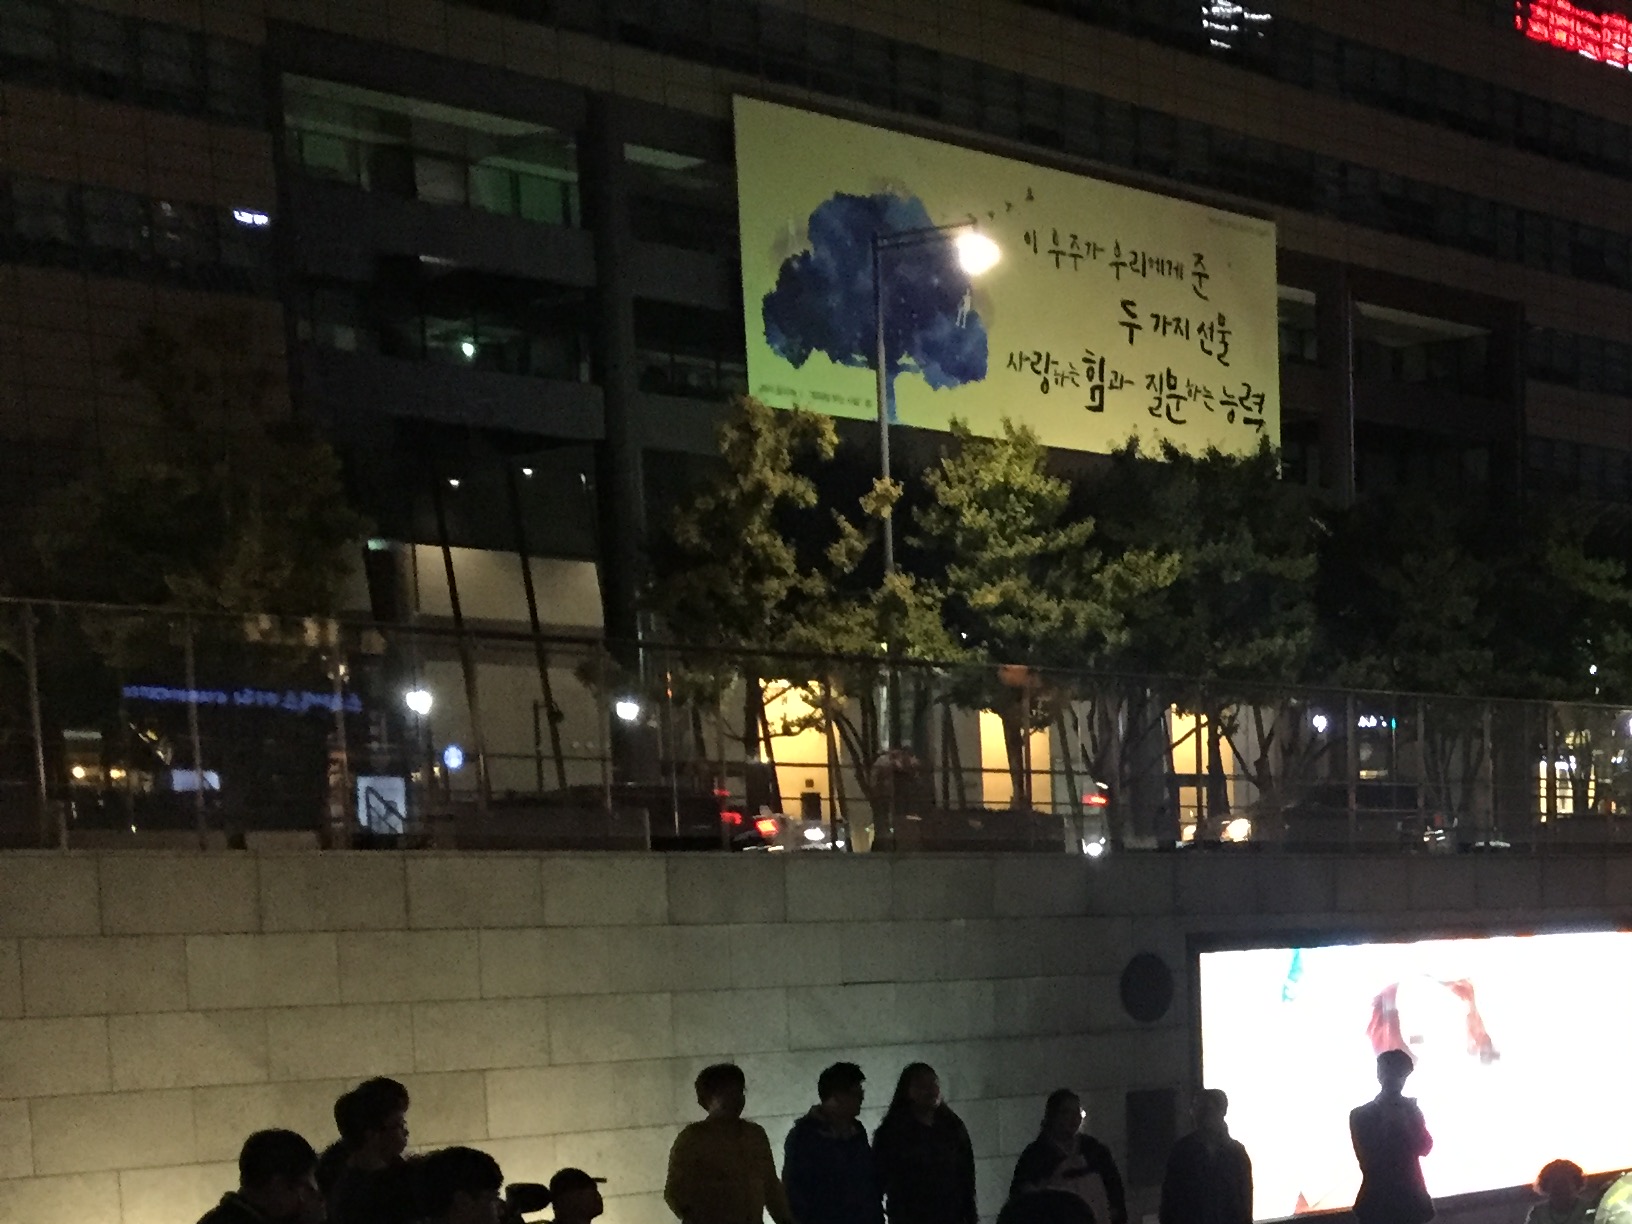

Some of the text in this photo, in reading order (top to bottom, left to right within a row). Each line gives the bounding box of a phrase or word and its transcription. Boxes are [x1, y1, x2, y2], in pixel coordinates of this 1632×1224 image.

[1023, 228, 1210, 301] 이 우주가 우리에게 준
[1118, 298, 1232, 367] 두 가지 선물
[1006, 348, 1265, 433] 사랑하는 힘과 질문하는 능력
